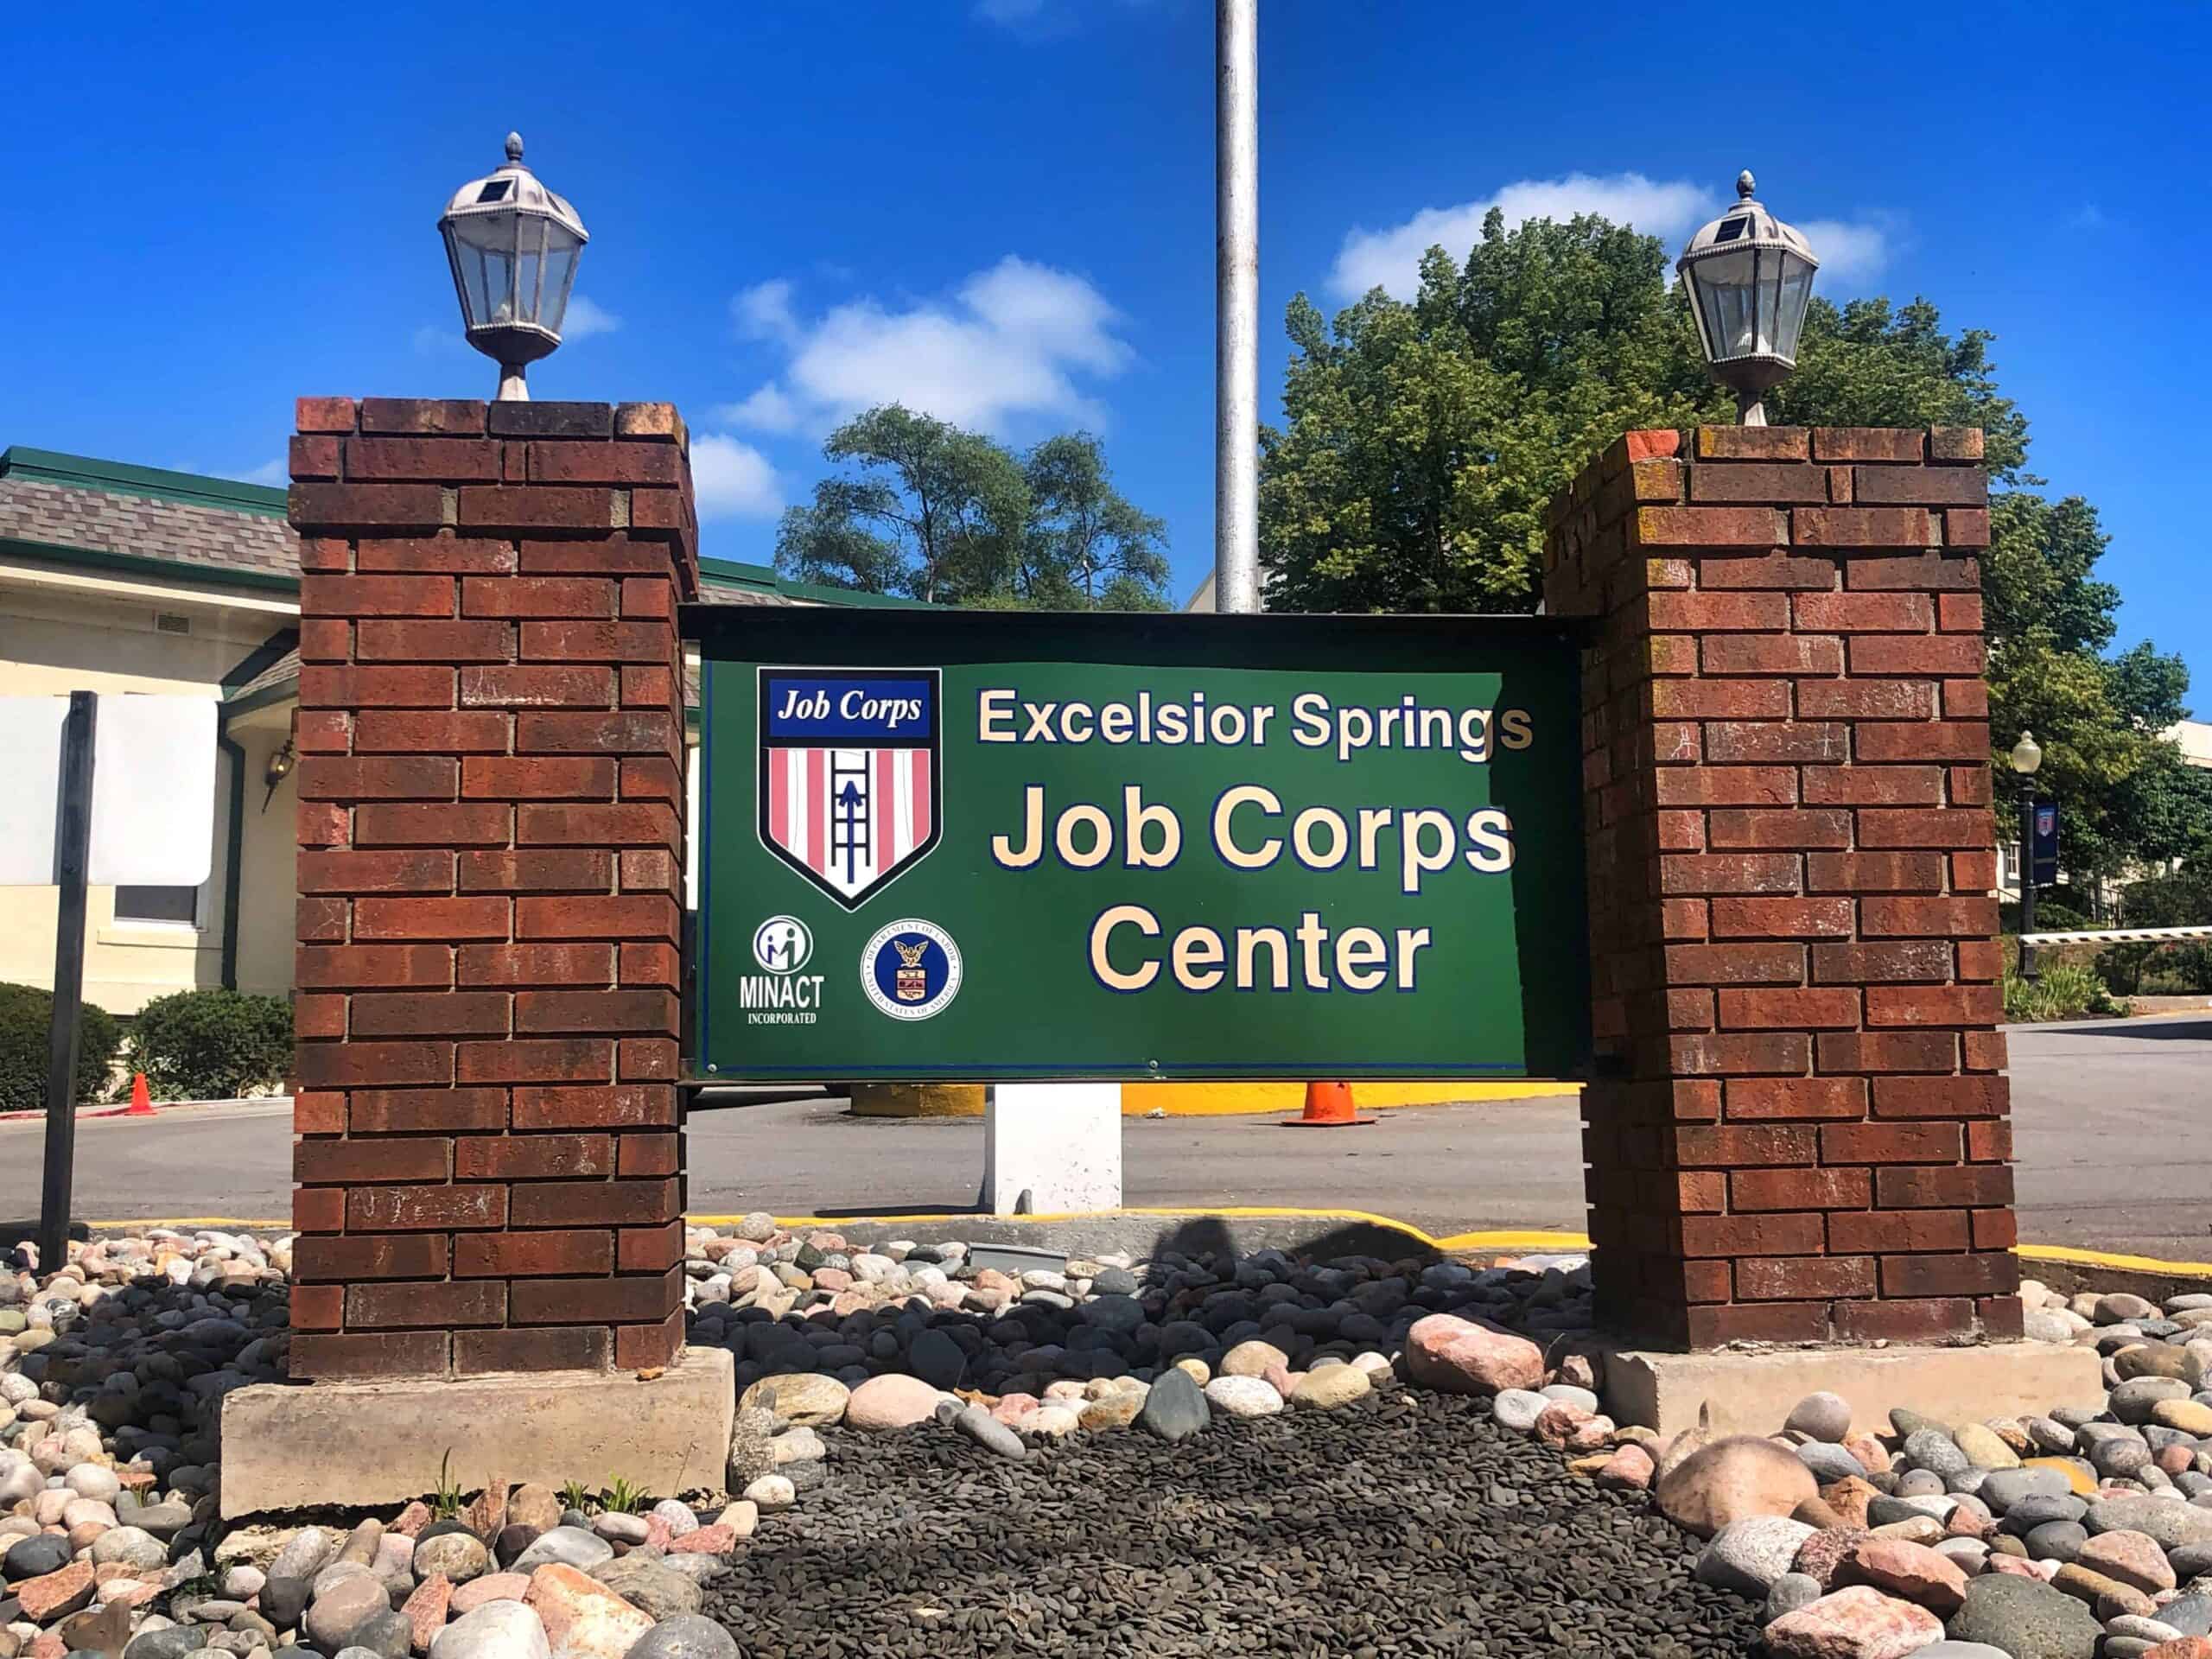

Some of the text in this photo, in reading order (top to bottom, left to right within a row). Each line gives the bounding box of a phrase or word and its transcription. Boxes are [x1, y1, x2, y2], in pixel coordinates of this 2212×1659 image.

[778, 690, 922, 728] Job Corps
[978, 689, 1534, 763] Excelsior Springs
[991, 784, 1516, 894] Job Corps
[934, 931, 957, 962] LABOR
[1090, 905, 1431, 992] Center
[740, 976, 825, 1008] MINACT
[747, 1013, 817, 1025] INCORPORATED
